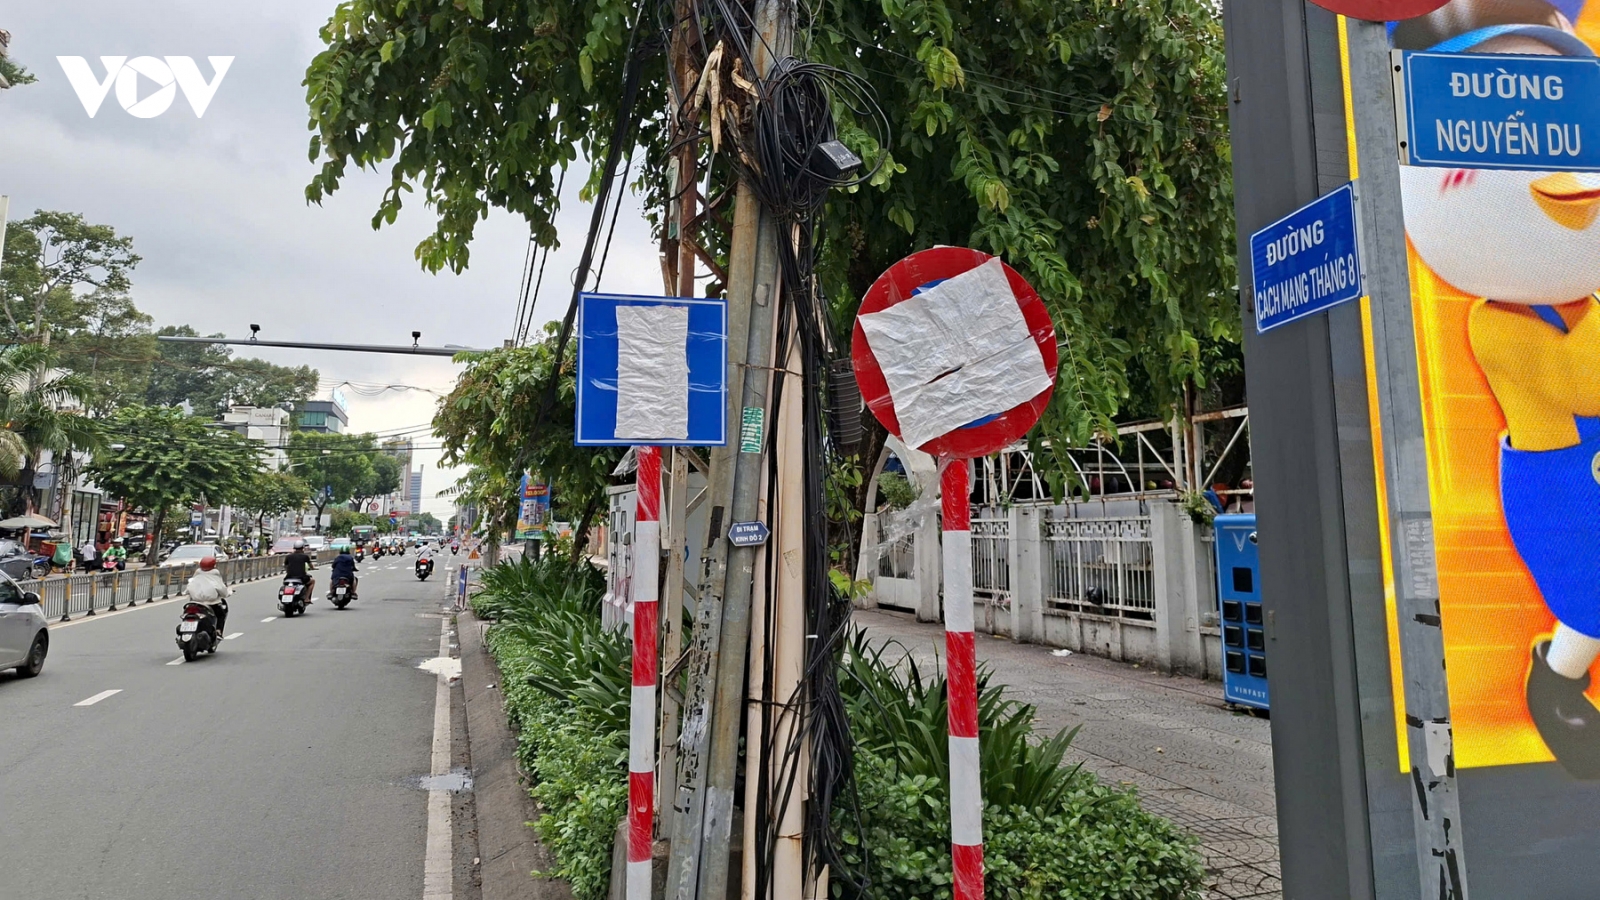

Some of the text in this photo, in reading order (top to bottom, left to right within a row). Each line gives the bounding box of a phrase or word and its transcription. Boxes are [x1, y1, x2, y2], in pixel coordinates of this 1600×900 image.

[1449, 68, 1564, 100] ĐƯỜNG
[1436, 110, 1581, 157] NGUYỄN DU
[1266, 220, 1325, 267] ĐƯỜNG
[1257, 252, 1356, 321] CÁCH MẠNG THÁNG 8
[743, 525, 759, 533] TRẠM
[1234, 686, 1266, 699] VINFAST
